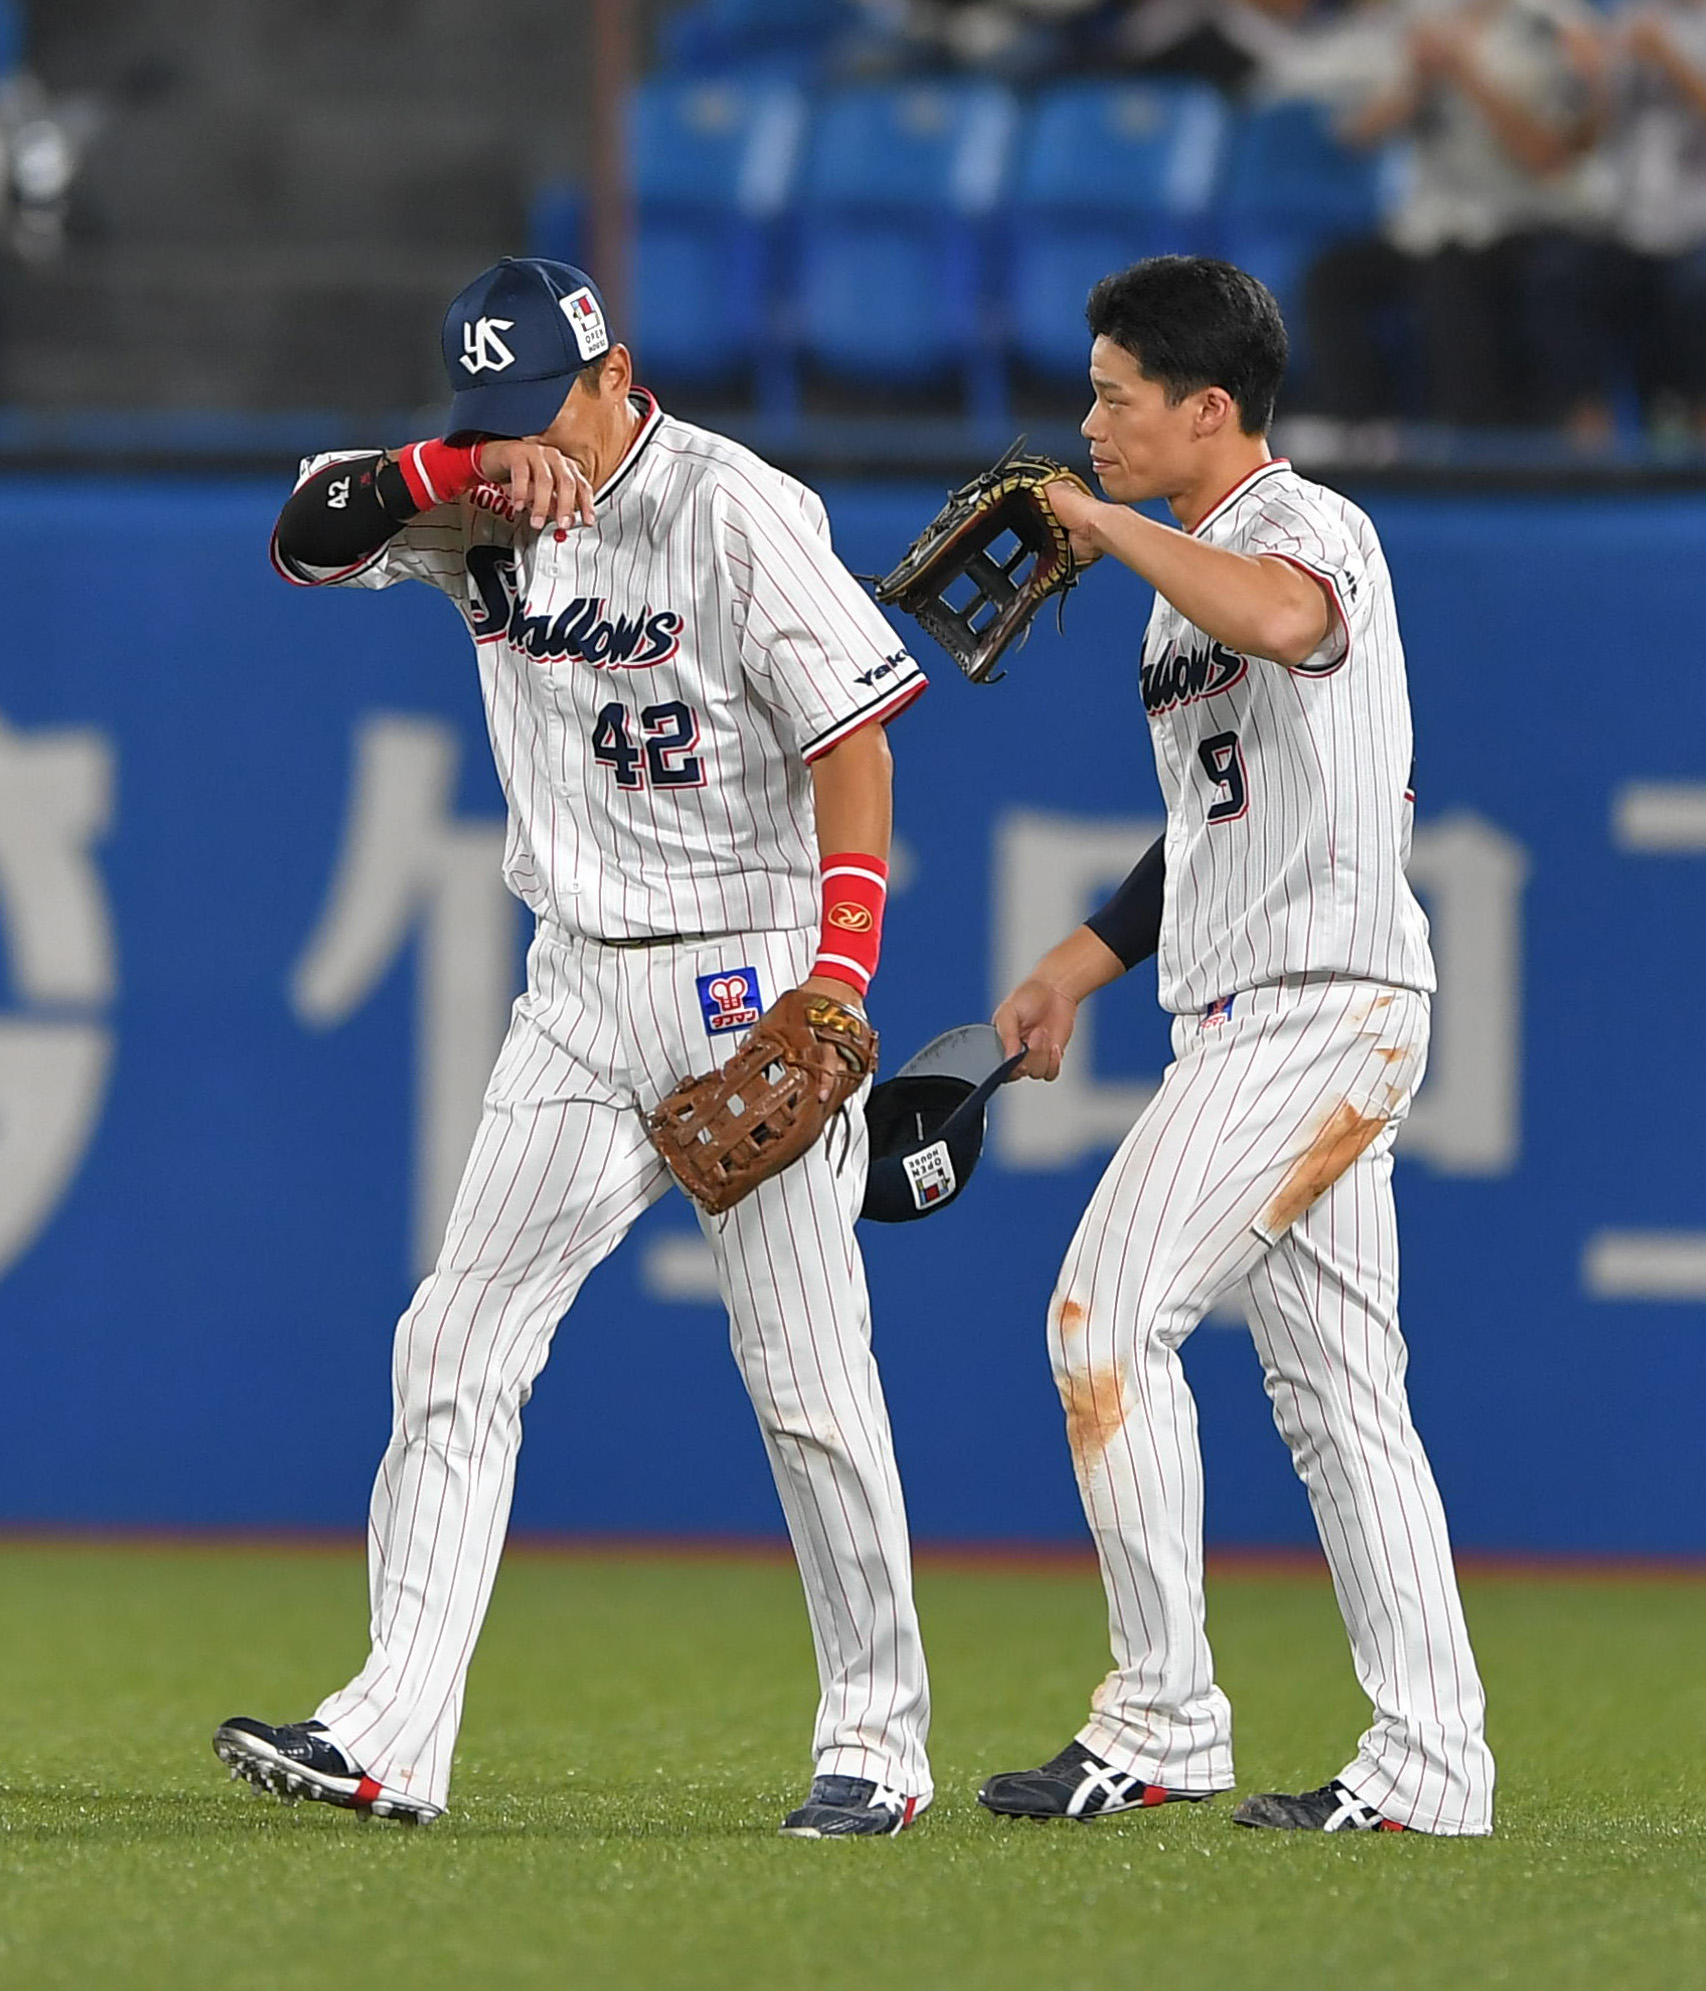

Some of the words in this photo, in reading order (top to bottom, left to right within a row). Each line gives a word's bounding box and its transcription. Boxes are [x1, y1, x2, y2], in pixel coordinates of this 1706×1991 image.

[327, 475, 351, 509] 42
[592, 700, 708, 791] 42
[1197, 730, 1249, 826] 9
[908, 1149, 939, 1168] HOUSE
[912, 1157, 942, 1178] OPEN
